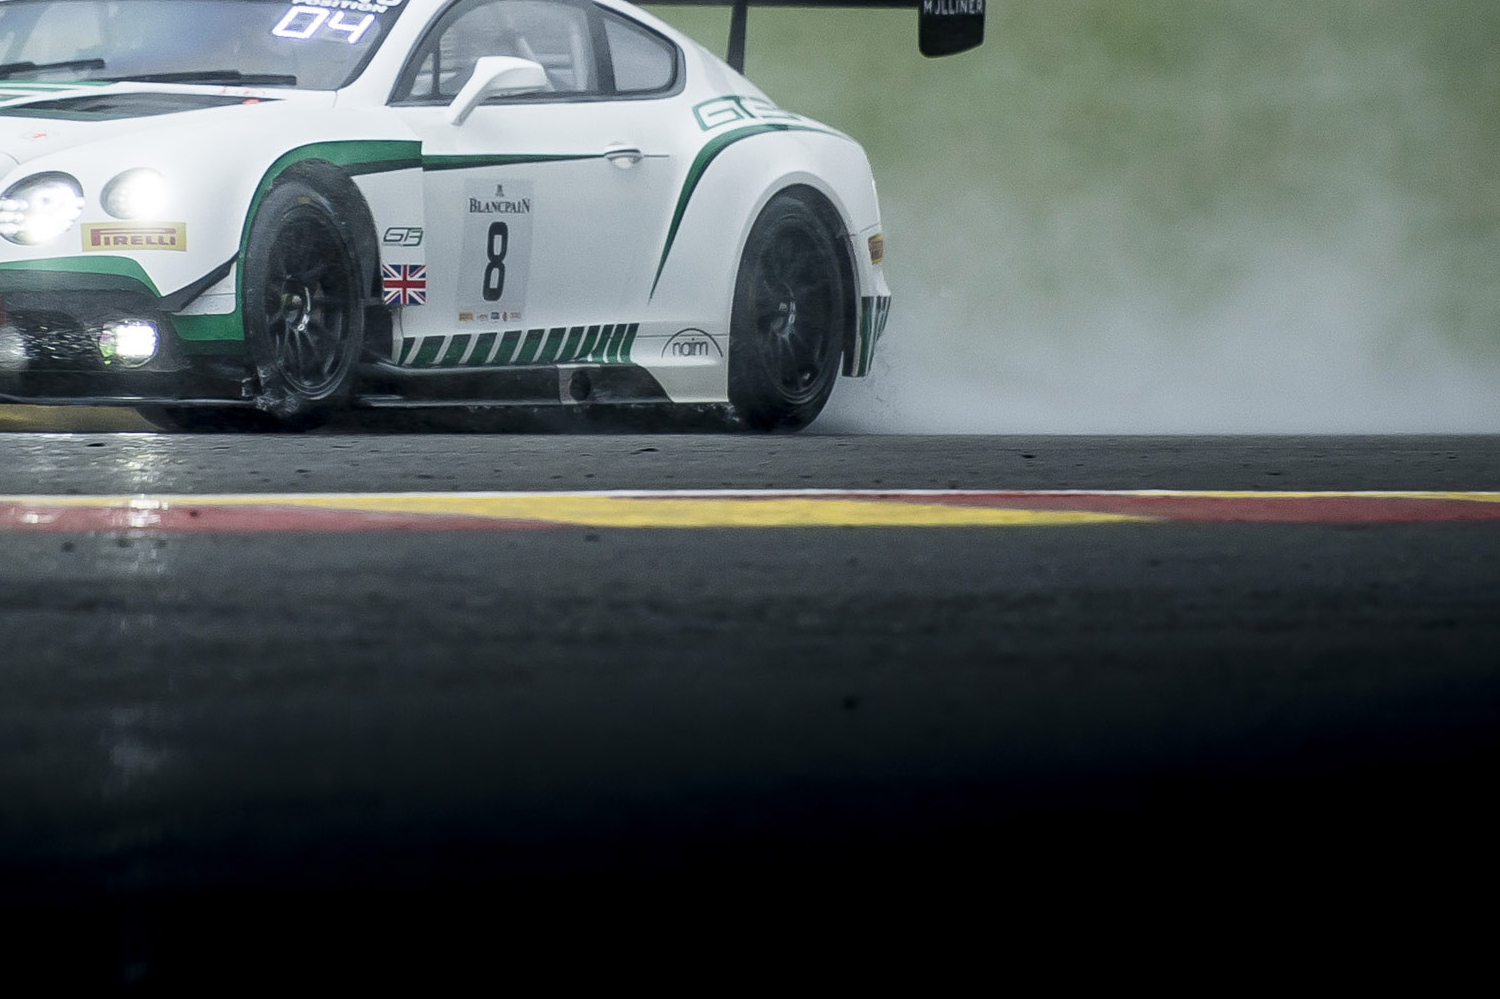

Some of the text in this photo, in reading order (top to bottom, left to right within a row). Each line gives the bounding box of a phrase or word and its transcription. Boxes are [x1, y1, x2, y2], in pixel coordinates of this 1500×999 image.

[271, 5, 376, 44] 04
[469, 197, 531, 214] BLANCPAIN
[90, 228, 176, 247] PIRELLI
[483, 221, 509, 302] 8
[673, 337, 709, 356] naim
